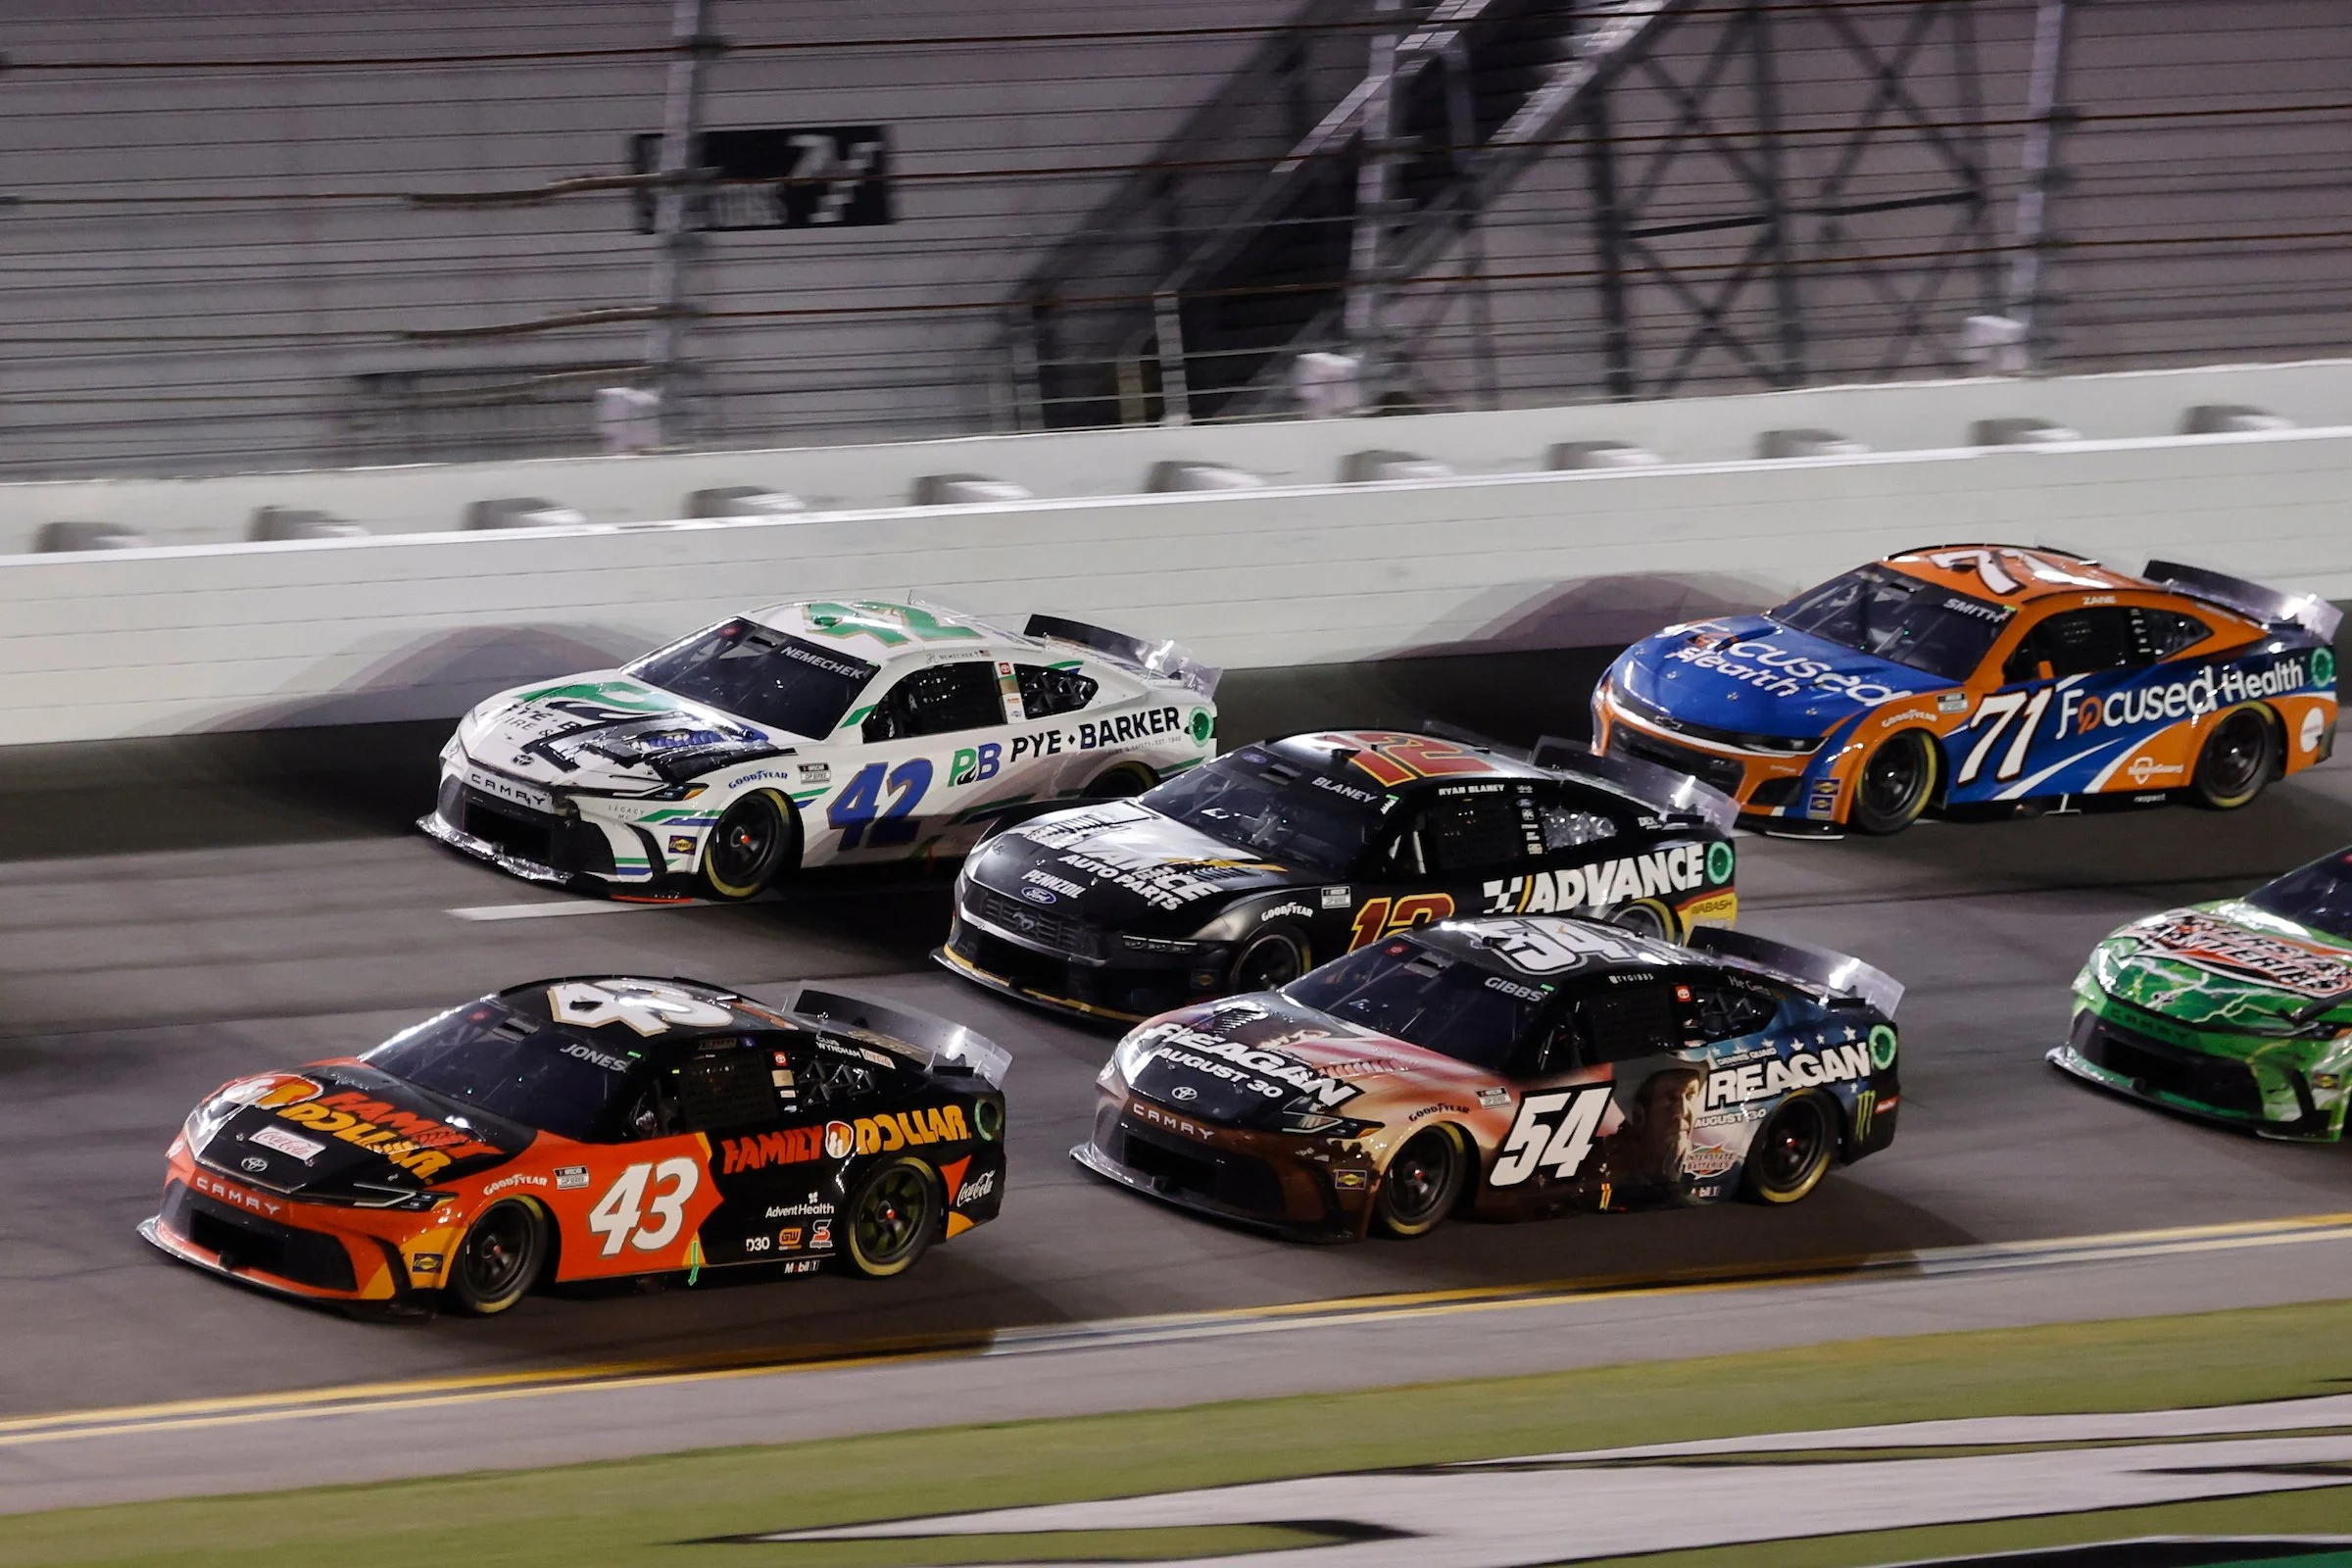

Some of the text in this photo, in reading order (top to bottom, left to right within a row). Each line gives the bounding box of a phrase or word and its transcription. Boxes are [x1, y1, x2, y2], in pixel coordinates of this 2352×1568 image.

[1929, 549, 2113, 595] 71
[801, 599, 990, 648] 42
[1943, 598, 2003, 623] SMITH
[780, 646, 863, 680] NEMECHEK
[1655, 621, 1914, 707] Fcused
[2056, 659, 2304, 740] Focused Health
[1009, 706, 1181, 763] PYE BARKER
[1957, 686, 2054, 783] 71
[728, 769, 789, 790] GOODYEAR
[947, 742, 1002, 788] PB
[1309, 732, 1501, 788] 12
[470, 773, 547, 807] CAMRY
[608, 804, 646, 816] LEGACY
[826, 757, 934, 852] 42
[1311, 776, 1377, 805] BLANEY
[1438, 787, 1466, 797] RYAN
[1468, 783, 1505, 794] BLANEY
[1020, 868, 1087, 900] PENNZOIL
[1056, 854, 1184, 911] AUTO PARTS
[1526, 843, 1705, 914] ADVANCE
[1260, 902, 1314, 922] GOODYEAR
[1475, 919, 1635, 972] 54
[547, 979, 734, 1038] 43
[1485, 977, 1543, 1003] GIBBS
[559, 1043, 627, 1074] JONES
[815, 1041, 862, 1059] WYNDHAM
[1137, 1022, 1357, 1107] REAGAN
[1154, 1047, 1284, 1099] AUGUST 30
[1707, 1041, 1871, 1108] REAGAN
[318, 1092, 505, 1160] FAMILY
[1133, 1102, 1215, 1141] CAMRY
[1408, 1102, 1470, 1122] GOODYEAR
[1694, 1108, 1767, 1128] AUGUST 30
[275, 1102, 452, 1179] DOLLAR
[722, 1125, 824, 1175] FAMILY
[1489, 1088, 1612, 1186] 54
[196, 1177, 281, 1215] CAMRY
[483, 1173, 549, 1197] GOODYEAR
[588, 1157, 699, 1257] 43
[765, 1202, 835, 1219] AdventHealth
